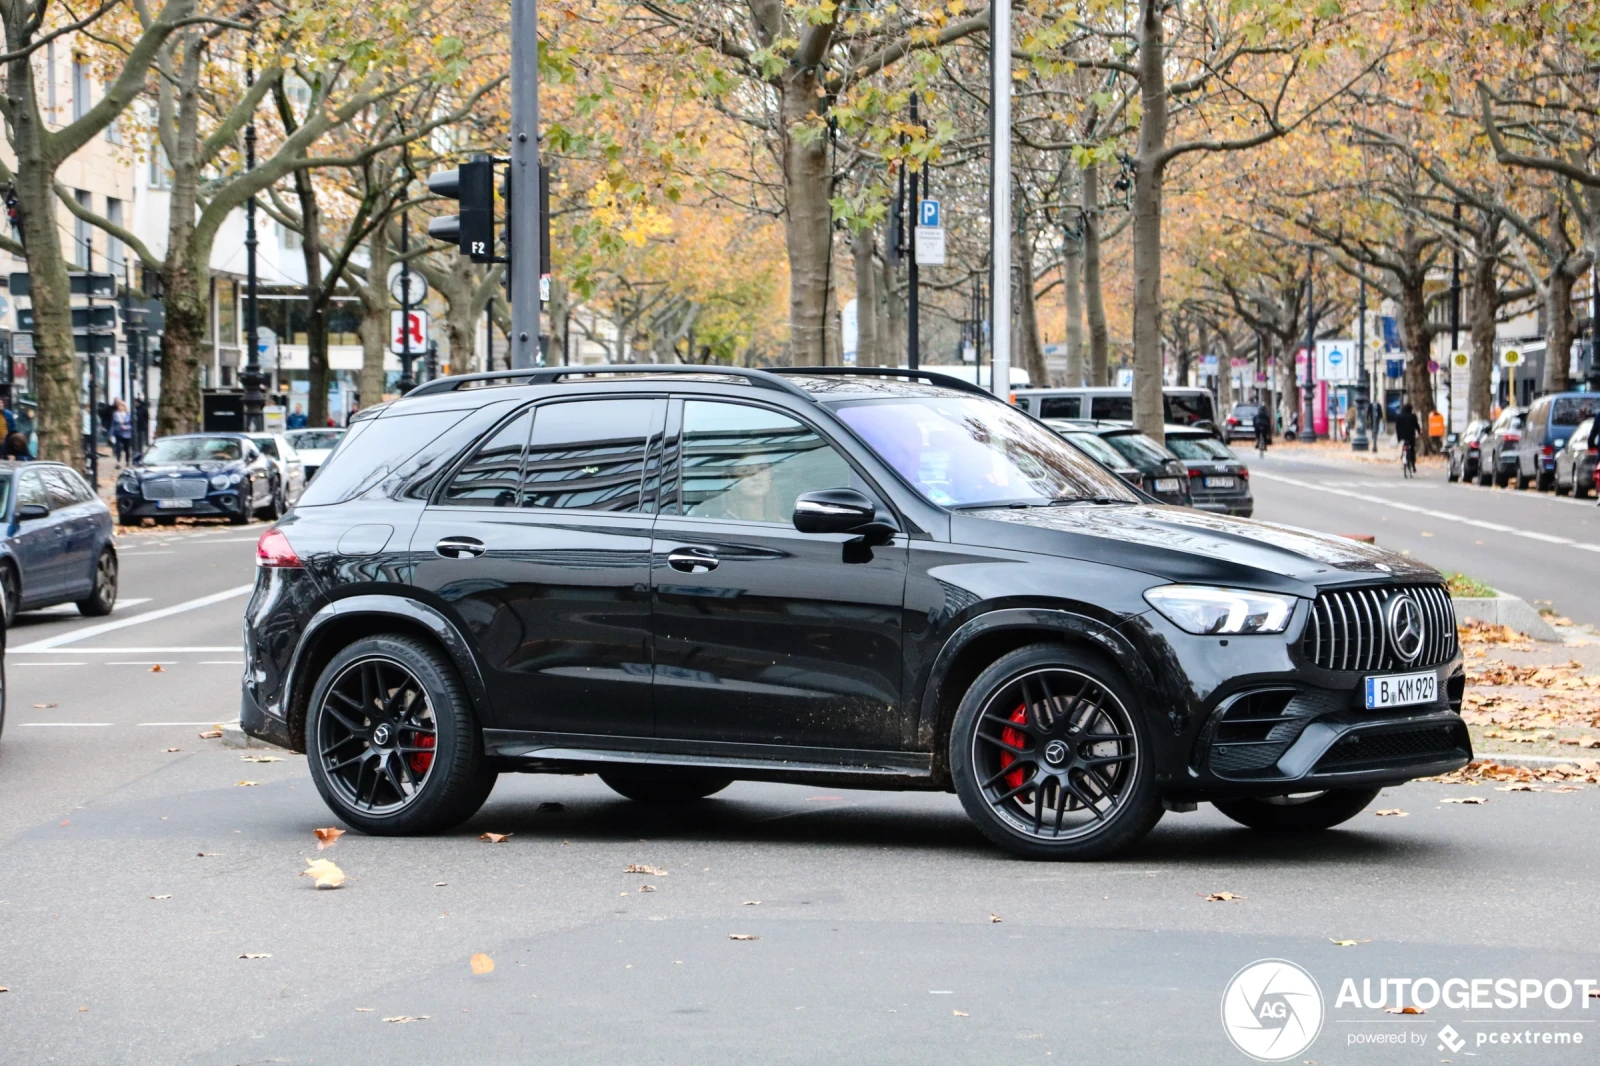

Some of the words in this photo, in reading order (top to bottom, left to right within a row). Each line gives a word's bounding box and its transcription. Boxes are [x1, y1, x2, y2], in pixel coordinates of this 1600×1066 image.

[924, 202, 936, 224] P
[472, 241, 485, 254] F2
[1380, 680, 1390, 703] B
[1416, 676, 1434, 700] 929
